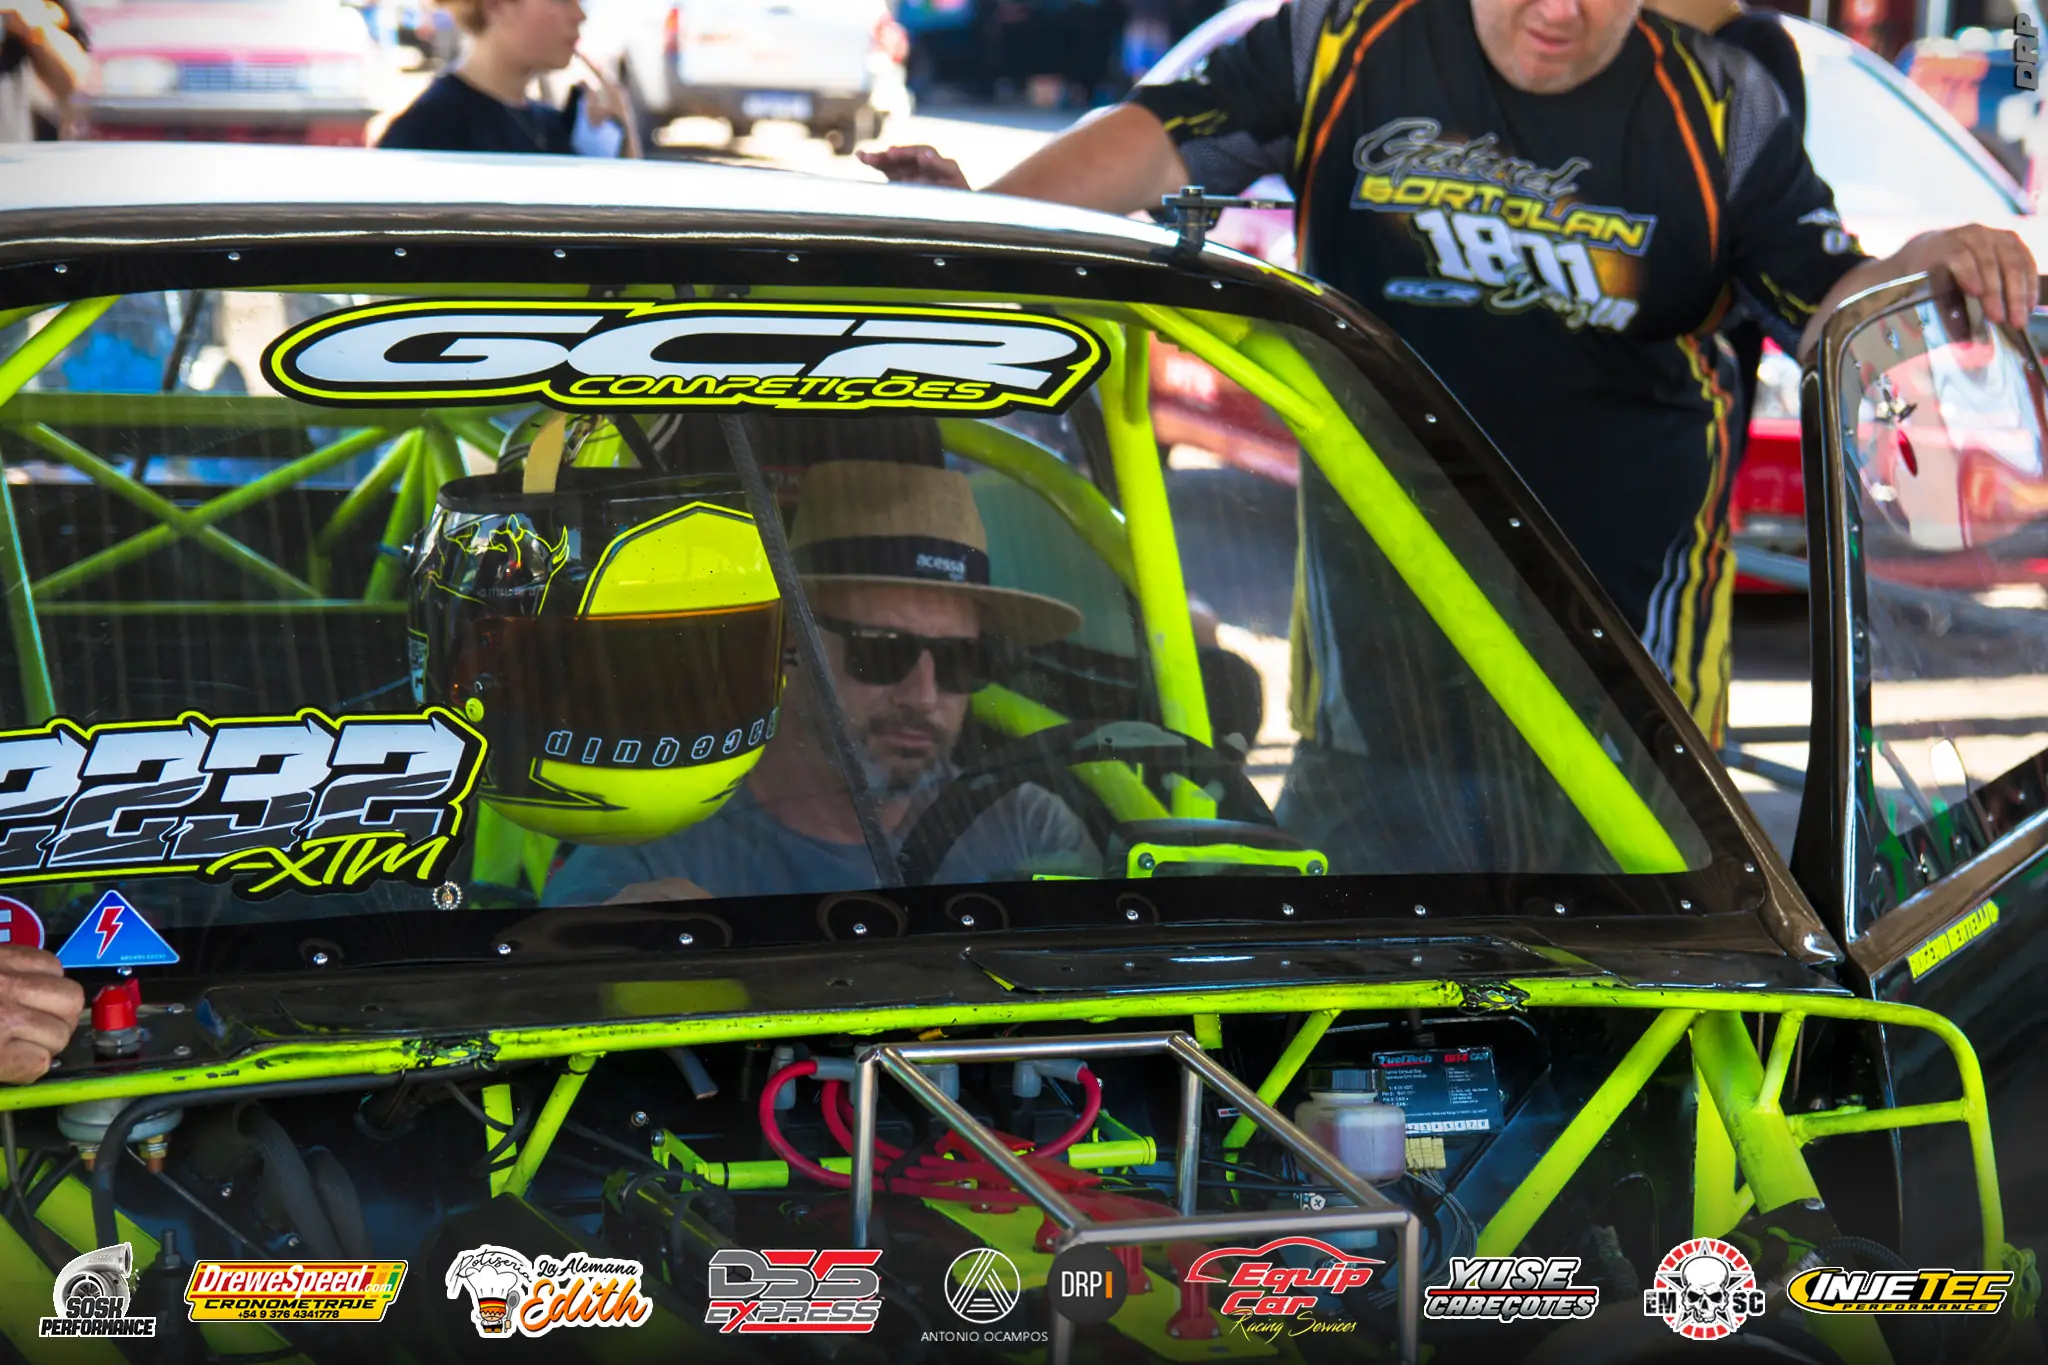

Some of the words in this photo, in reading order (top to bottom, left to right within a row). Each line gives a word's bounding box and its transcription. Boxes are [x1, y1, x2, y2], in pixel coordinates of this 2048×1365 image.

[1360, 174, 1644, 248] BORTOLAN
[296, 315, 1077, 390] GCR
[569, 375, 992, 401] COMPETIÇÕES
